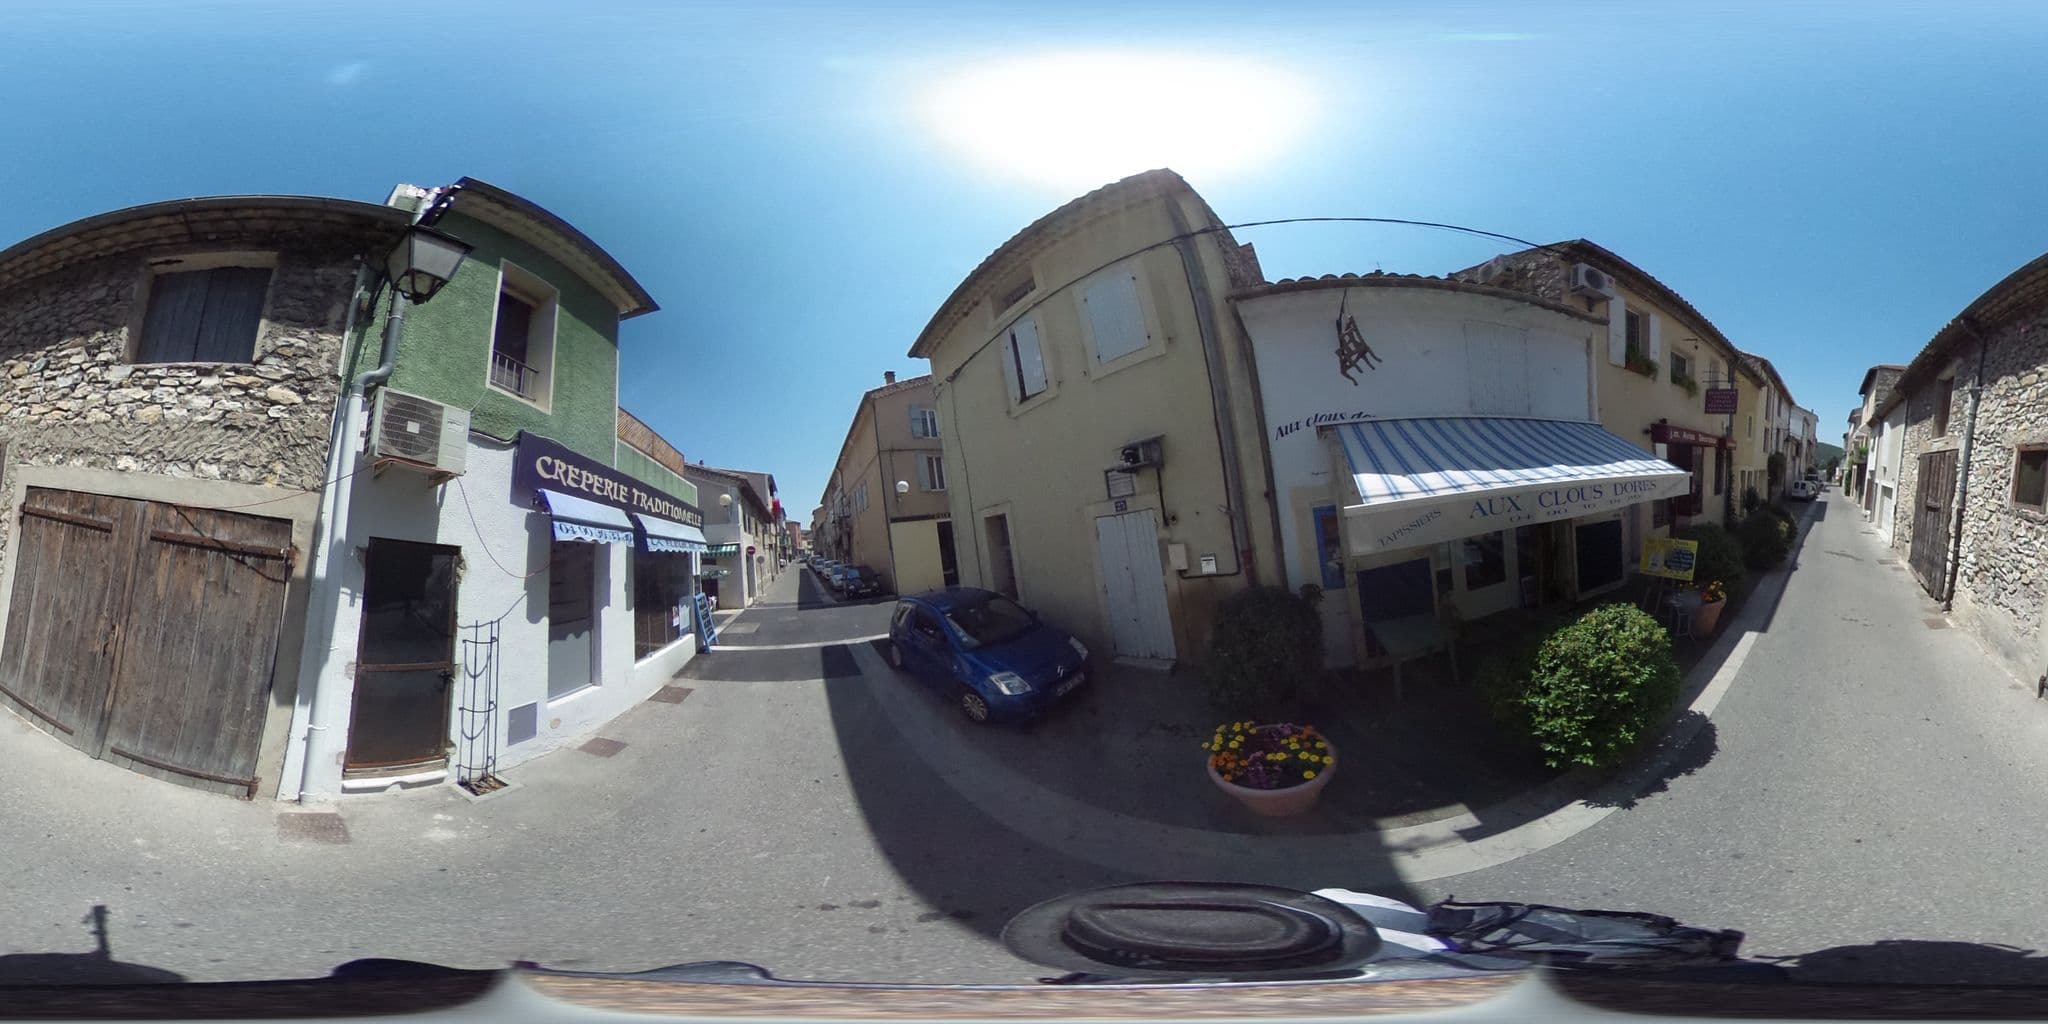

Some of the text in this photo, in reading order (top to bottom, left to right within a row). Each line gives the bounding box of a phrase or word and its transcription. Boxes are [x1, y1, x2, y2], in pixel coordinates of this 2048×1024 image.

[1275, 420, 1300, 441] Aux
[1305, 412, 1346, 428] clous
[535, 455, 703, 527] CREPERIE TRADITIONNELLE
[1470, 479, 1657, 519] AUX CLOUS DORES
[559, 523, 577, 535] 04
[1378, 509, 1441, 547] TAPISSIERS
